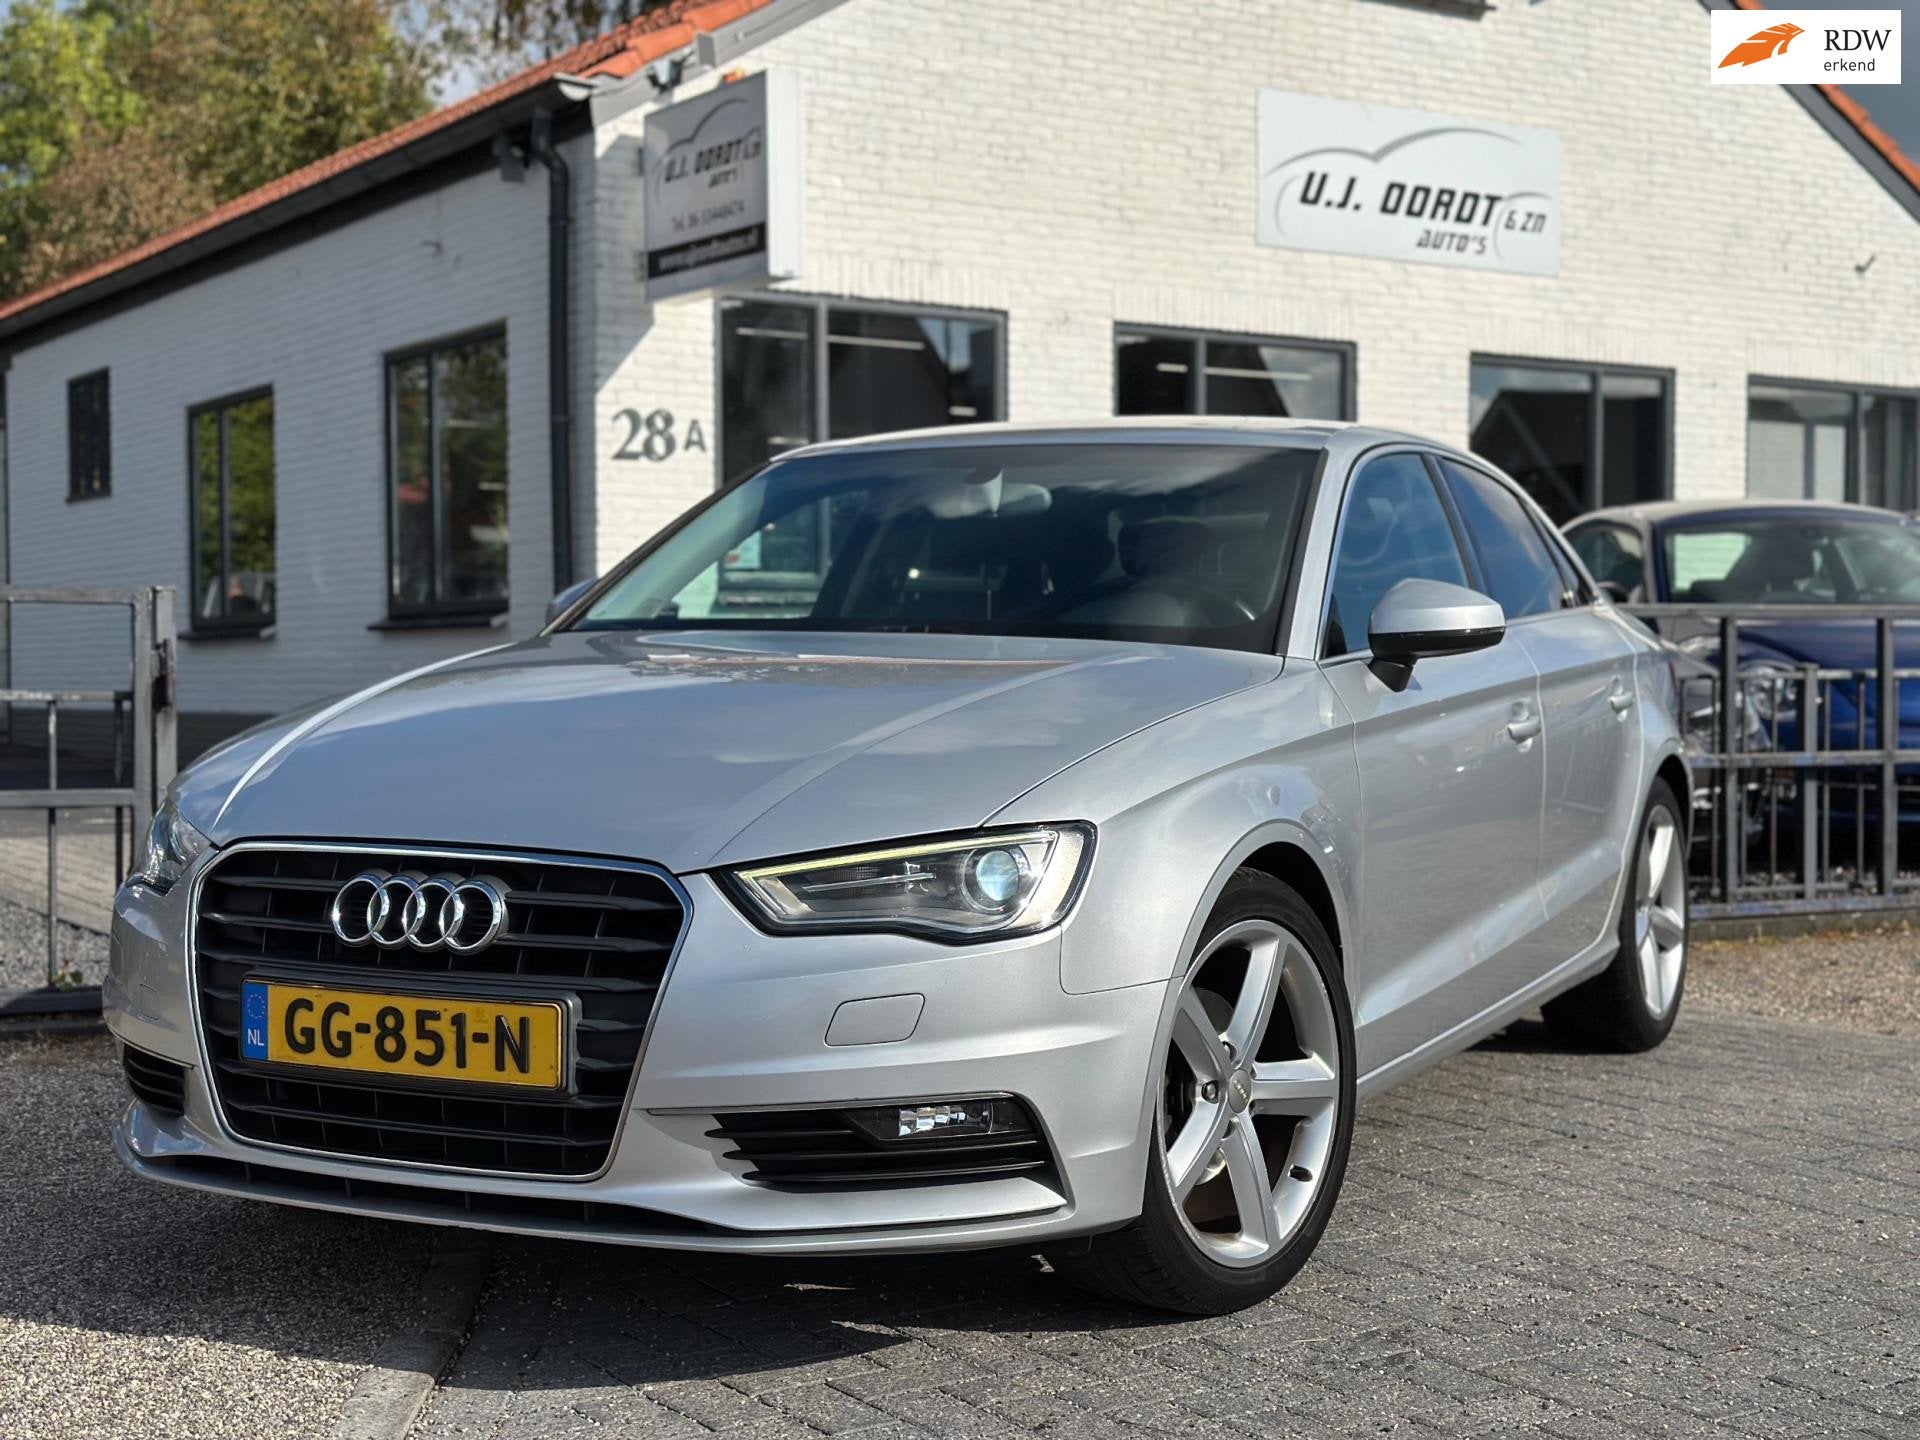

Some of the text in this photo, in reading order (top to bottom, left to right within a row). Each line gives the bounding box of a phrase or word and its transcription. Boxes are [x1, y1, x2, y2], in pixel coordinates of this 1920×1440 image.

[1299, 171, 1361, 211] U.J.
[1380, 182, 1502, 227] OORDT
[610, 408, 707, 463] 28 A
[247, 1028, 265, 1047] NL
[284, 997, 530, 1074] GG-851-N
